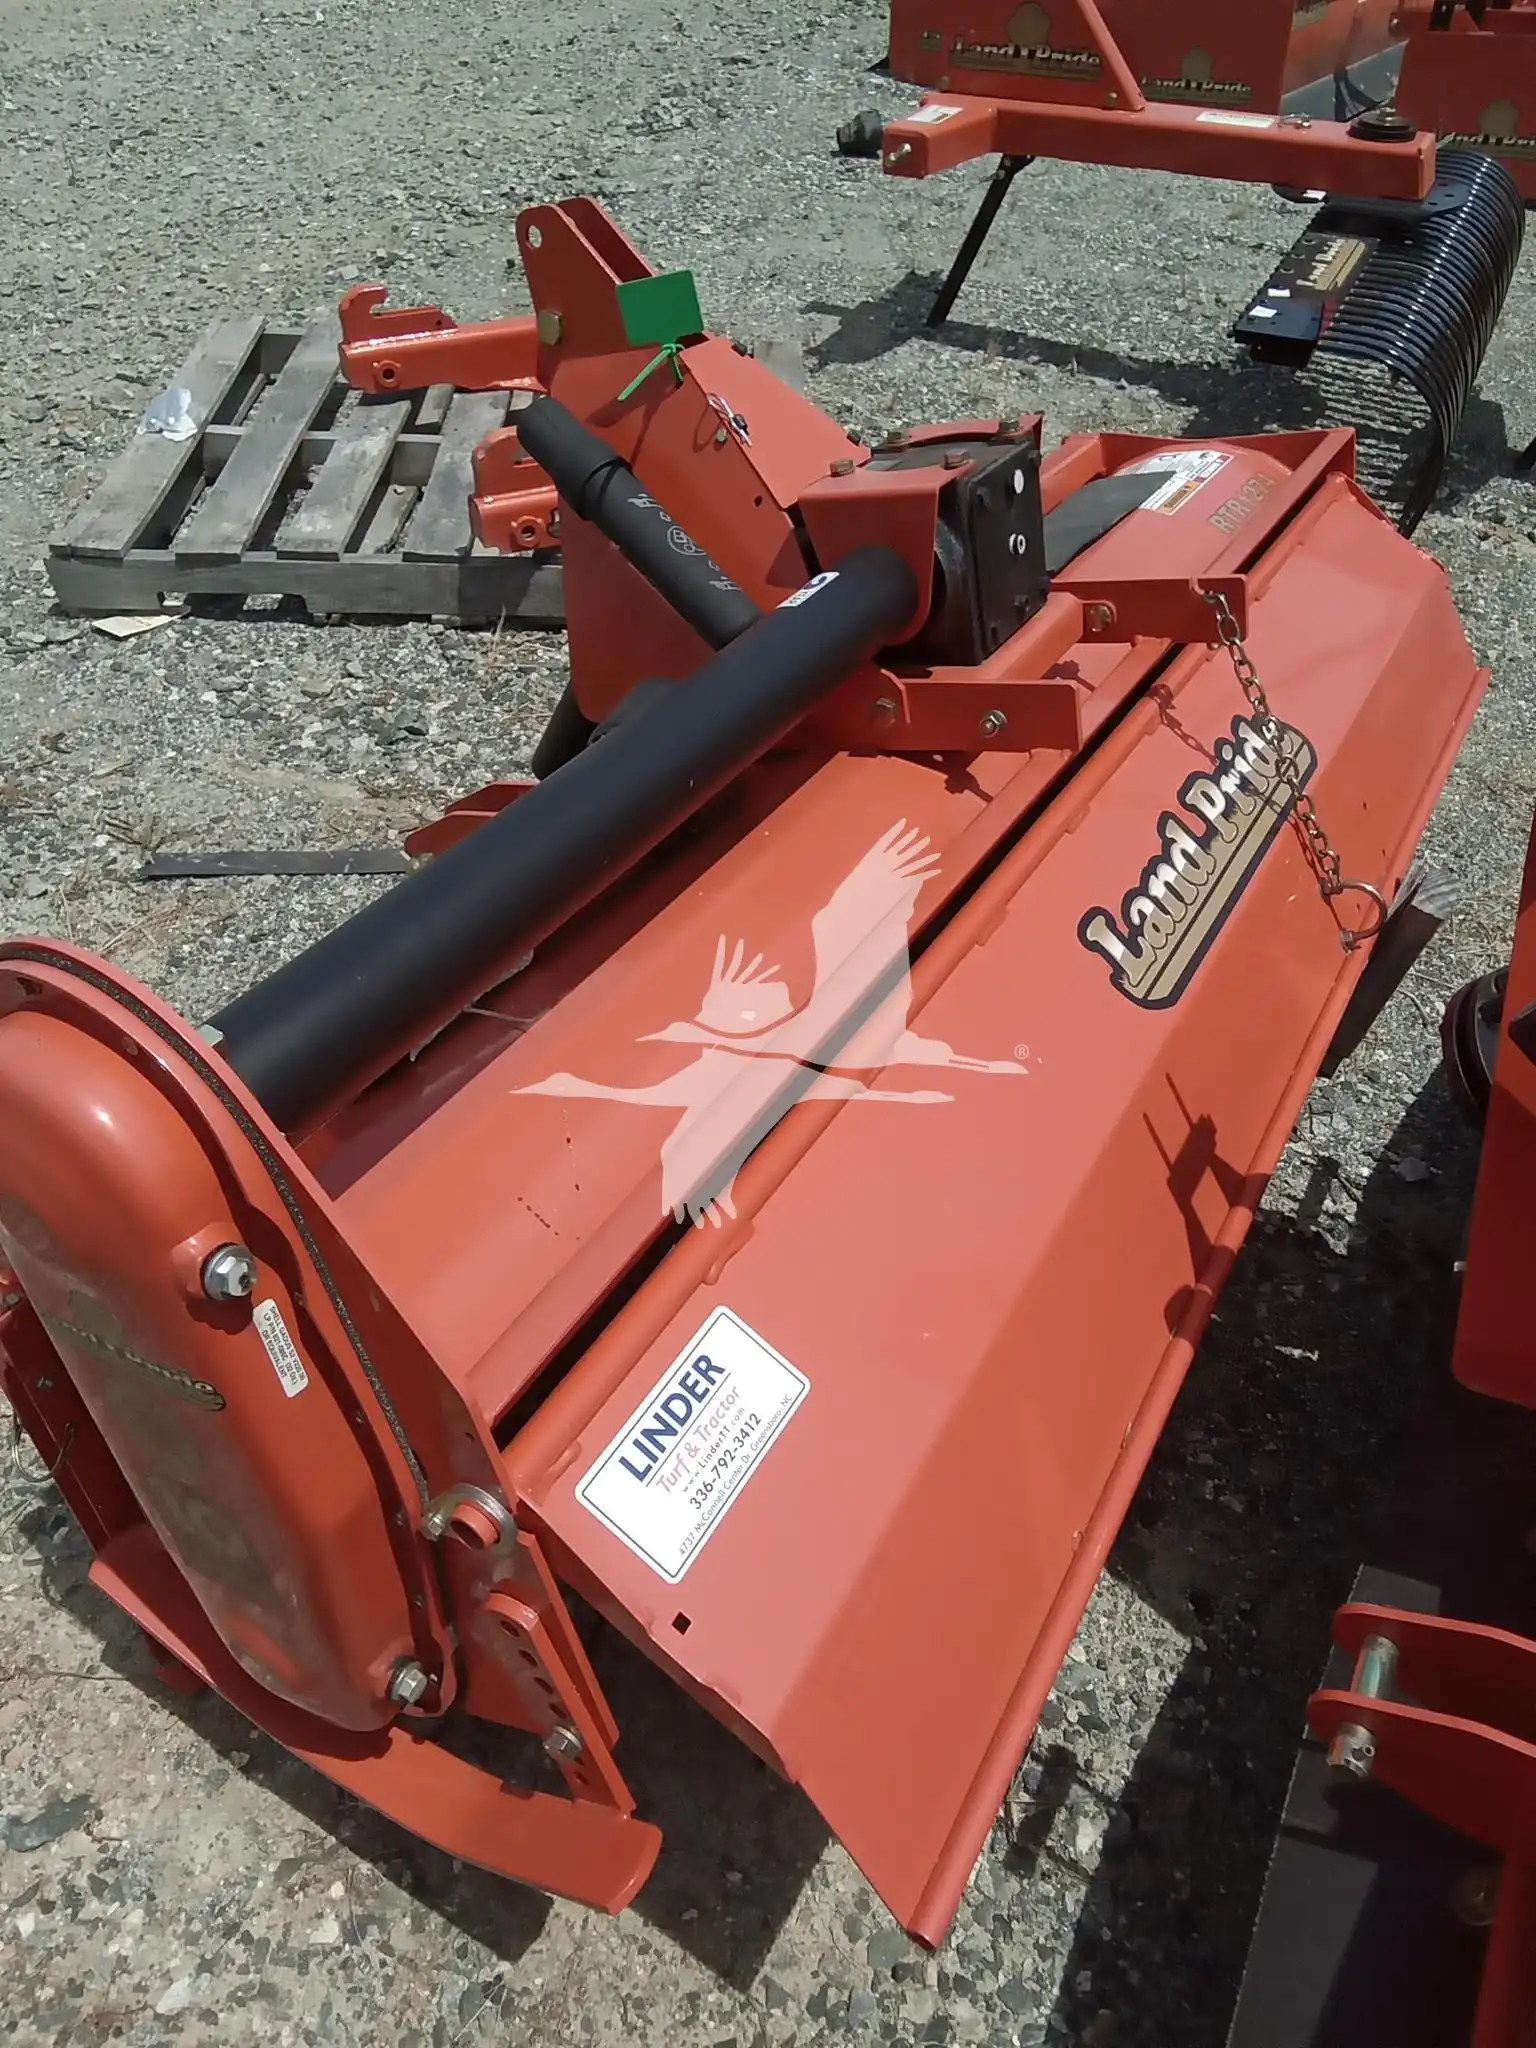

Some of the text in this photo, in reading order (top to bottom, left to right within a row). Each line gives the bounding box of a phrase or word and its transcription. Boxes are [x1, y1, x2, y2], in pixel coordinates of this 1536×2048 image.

[1084, 815, 1217, 988] Land
[261, 1329, 287, 1378] OR EQUIVALENT
[618, 1354, 726, 1483] LINDER
[656, 1385, 741, 1495] Turf & Tractor
[679, 1531, 696, 1556] 4737
[694, 1490, 726, 1534] McConnell
[722, 1462, 744, 1491] Center
[780, 1393, 793, 1408] NC
[689, 1412, 762, 1510] 336-792-3412
